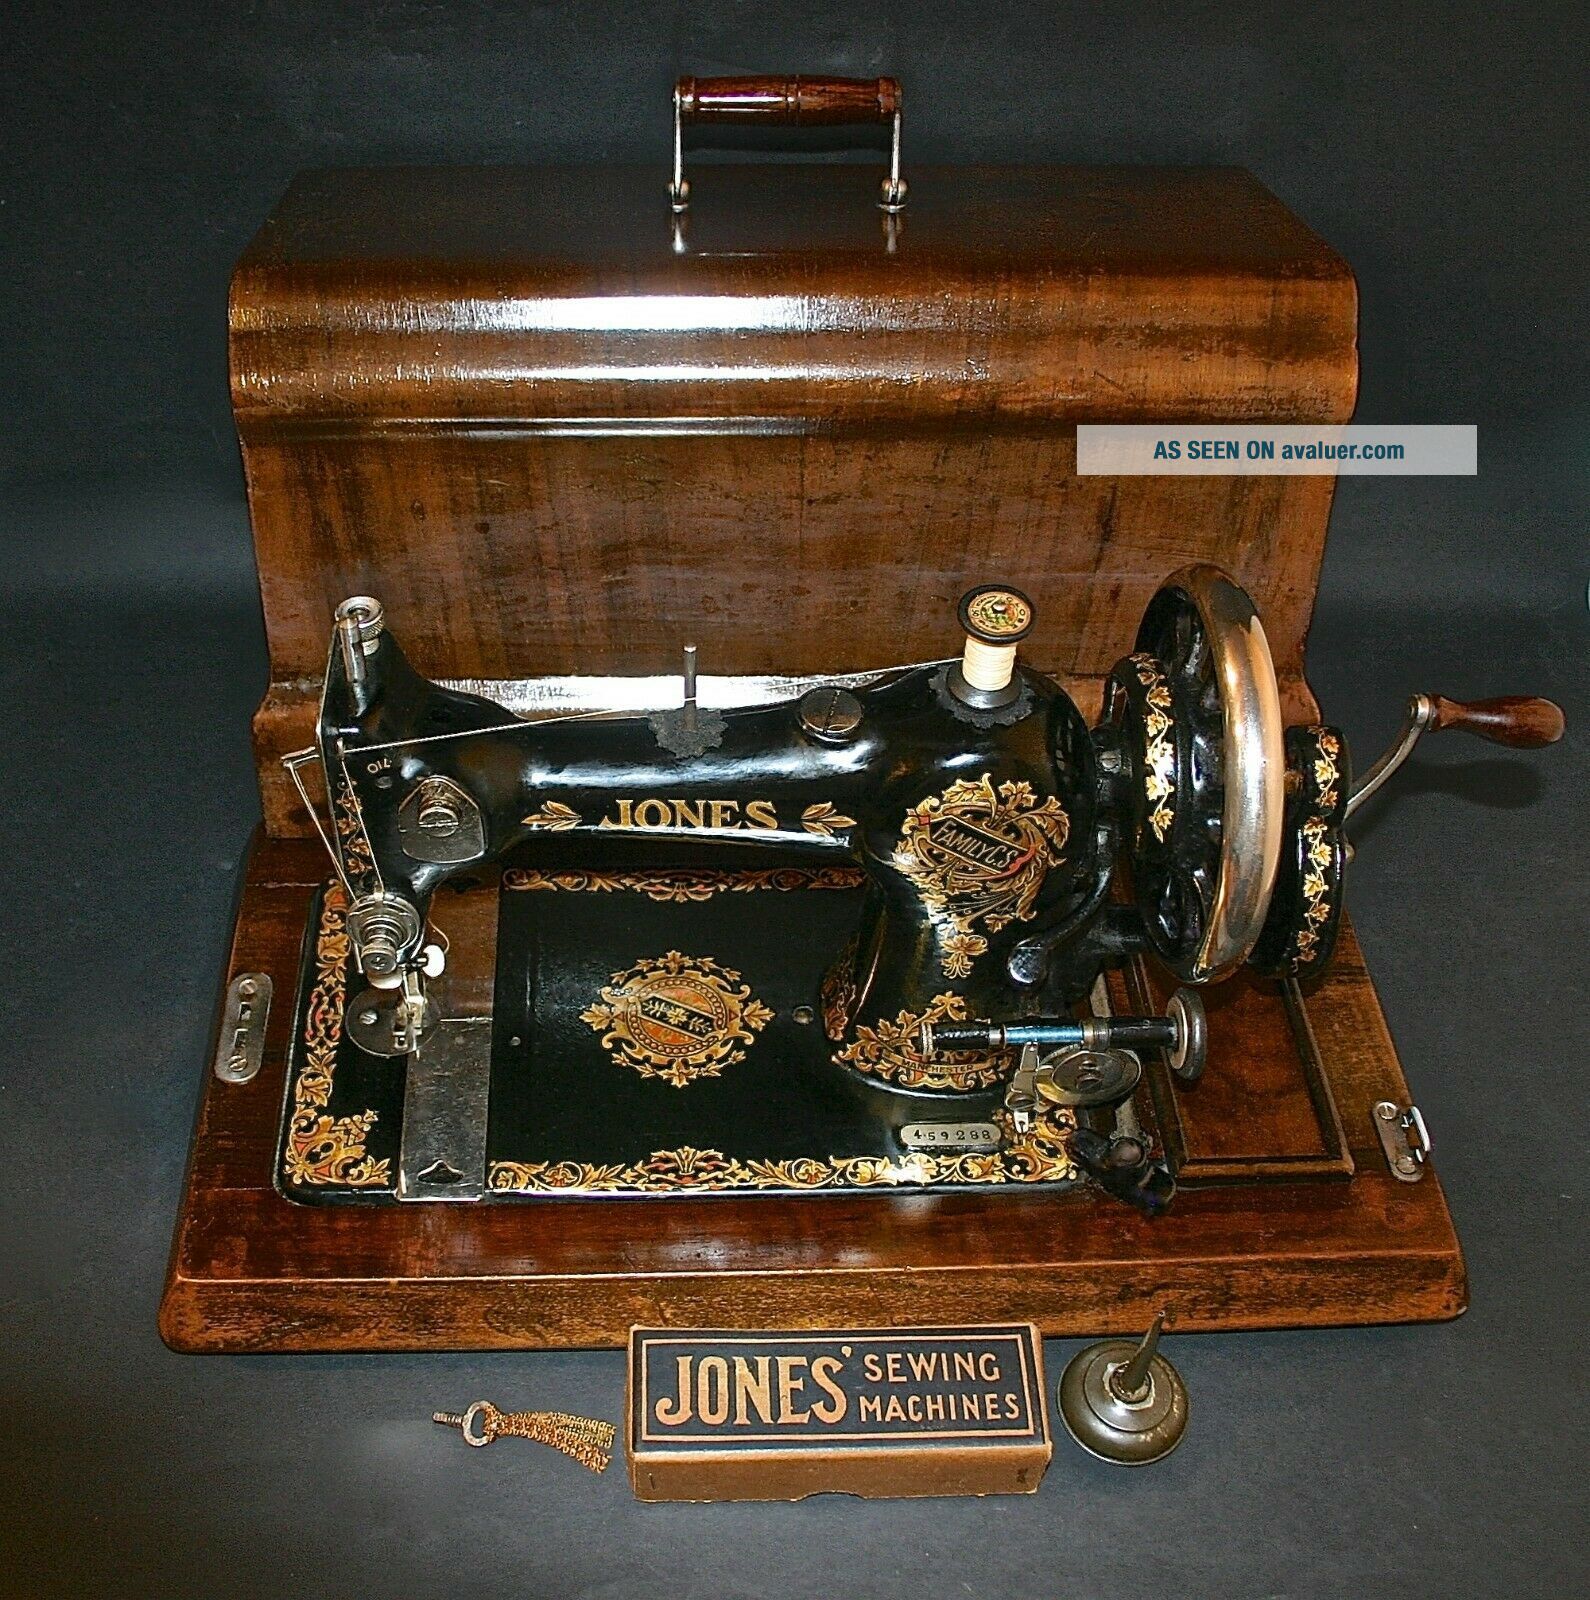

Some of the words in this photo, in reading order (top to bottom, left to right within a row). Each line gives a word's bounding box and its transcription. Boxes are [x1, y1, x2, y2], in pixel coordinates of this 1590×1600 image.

[600, 799, 779, 829] JONES
[931, 820, 995, 859] FAMILY
[902, 1058, 974, 1073] MANCHESTER
[863, 1352, 1001, 1383] SEWING
[654, 1345, 856, 1426] JONES'
[859, 1392, 1021, 1423] MACHINES
